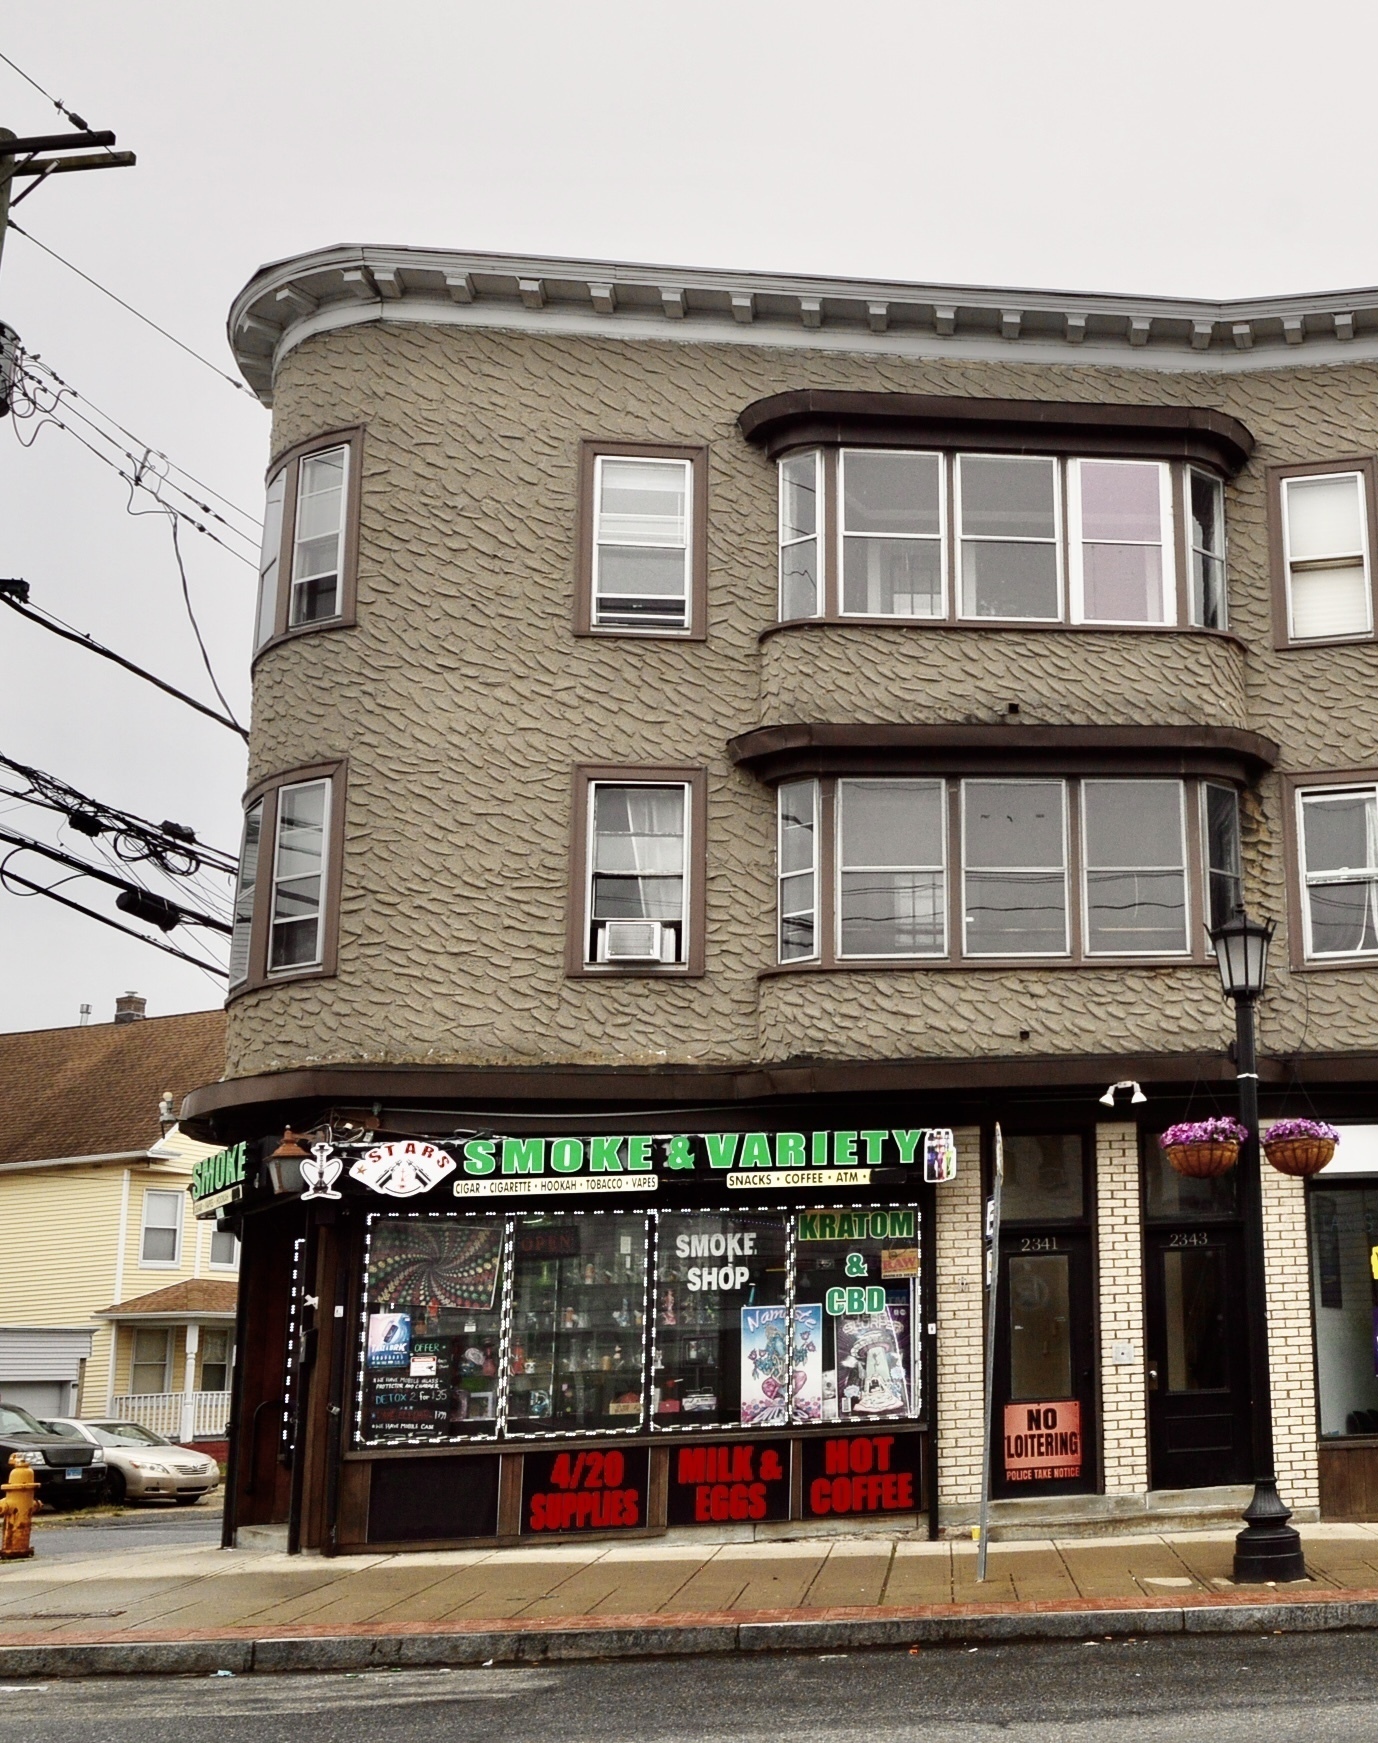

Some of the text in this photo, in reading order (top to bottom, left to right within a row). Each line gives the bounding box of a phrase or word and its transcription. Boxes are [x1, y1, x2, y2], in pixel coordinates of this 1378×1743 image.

[368, 1143, 450, 1168] STARS
[463, 1129, 922, 1175] SMOKE & VARIETY
[192, 1141, 247, 1201] SMOKE
[728, 1171, 859, 1187] SNACKS COFFEE ATM
[455, 1177, 656, 1194] CIGAR CIGARETTE HOOKAH TOBACCO VAPES
[799, 1211, 914, 1241] KRATOM
[675, 1232, 758, 1258] SMOKE
[1021, 1237, 1058, 1251] 2341
[1169, 1232, 1209, 1247] 2343
[845, 1253, 868, 1277] &
[883, 1257, 916, 1270] RAW
[686, 1266, 750, 1291] SHOP
[825, 1286, 886, 1315] CBD
[414, 1342, 440, 1352] OFFER
[375, 1393, 407, 1405] DETOX
[409, 1391, 418, 1402] 2
[419, 1391, 430, 1401] for
[1027, 1408, 1057, 1431] NO
[824, 1436, 895, 1475] HOT
[1006, 1431, 1079, 1459] LOITERING
[550, 1450, 625, 1489] 4/20
[677, 1446, 783, 1485] MILK &
[1006, 1467, 1080, 1481] POLICE TAKE NOTICE
[695, 1483, 767, 1522] EGGS
[810, 1473, 913, 1515] COFFEE
[529, 1488, 639, 1531] SUPPLIES
